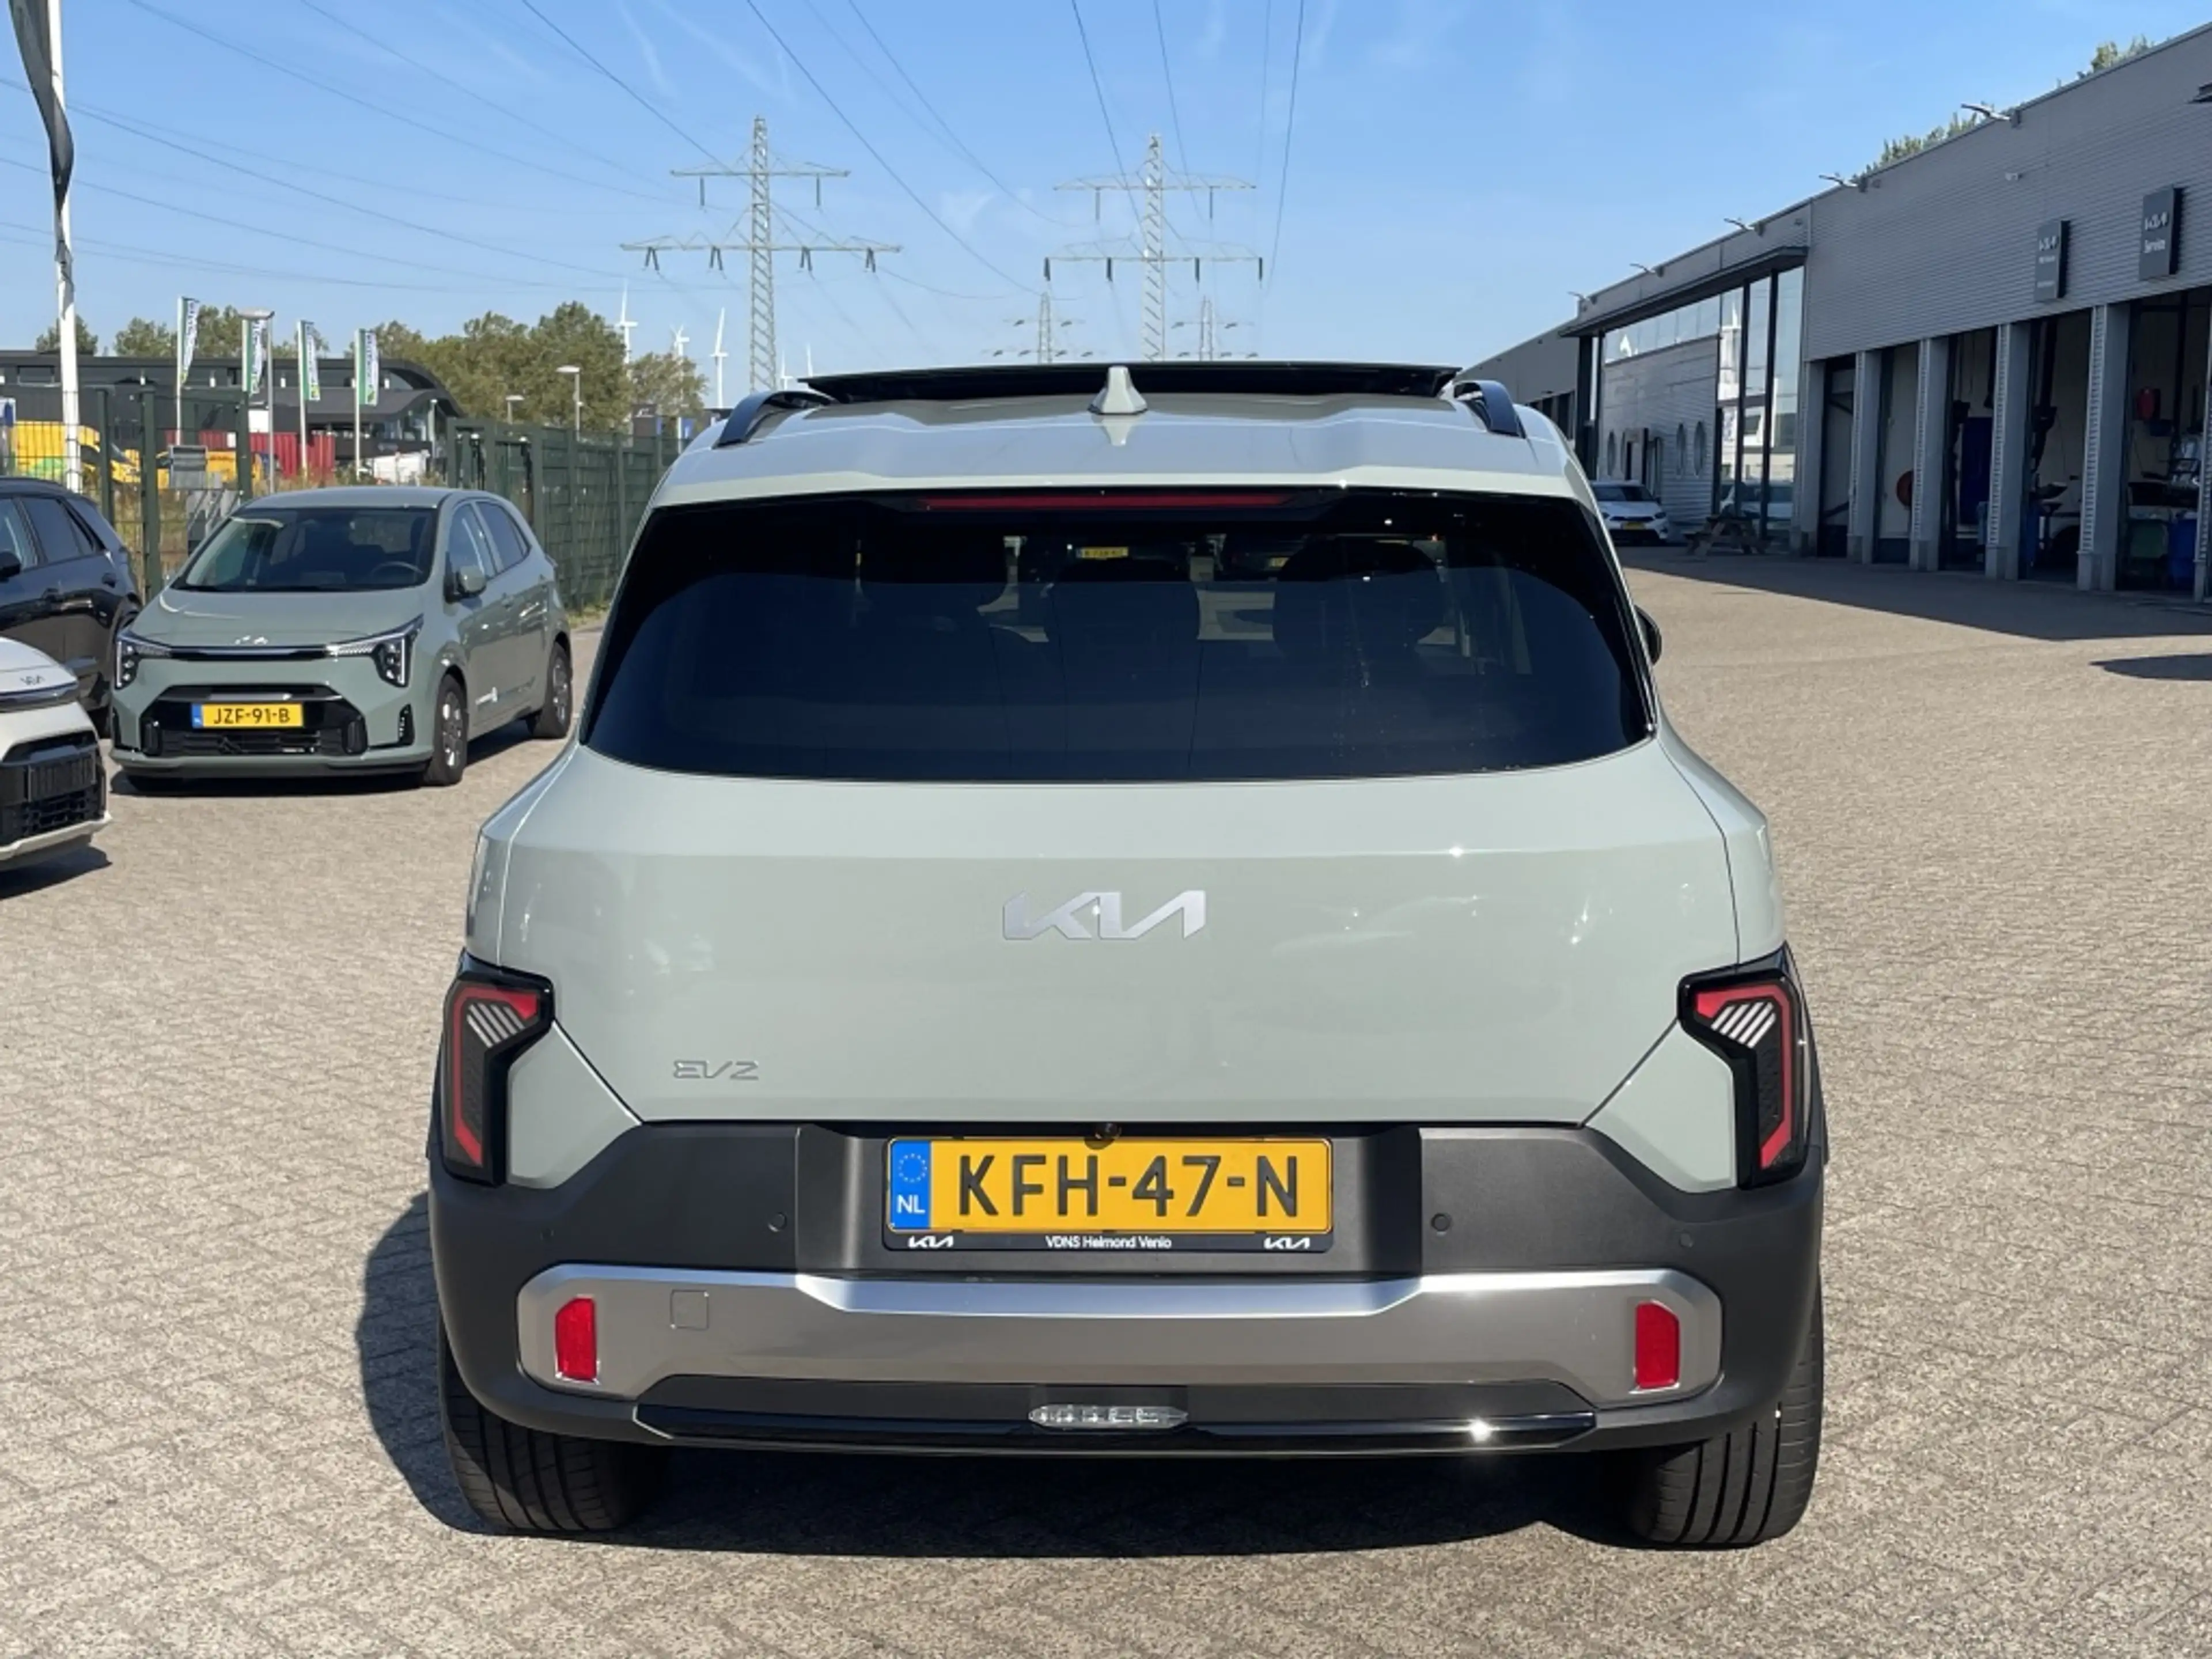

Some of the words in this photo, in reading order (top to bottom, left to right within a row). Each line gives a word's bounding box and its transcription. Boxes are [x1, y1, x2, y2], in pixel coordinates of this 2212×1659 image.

[213, 707, 291, 725] JZF-91-B
[1003, 889, 1207, 940] KIA
[673, 1060, 759, 1081] EV2
[959, 1154, 1298, 1217] KFH-47-N
[896, 1194, 926, 1214] NL
[908, 1236, 954, 1248] KIA
[1045, 1235, 1081, 1248] VDNS
[1082, 1235, 1137, 1249] Helmond
[1138, 1235, 1172, 1249] Venlo
[1264, 1237, 1310, 1249] KIA
